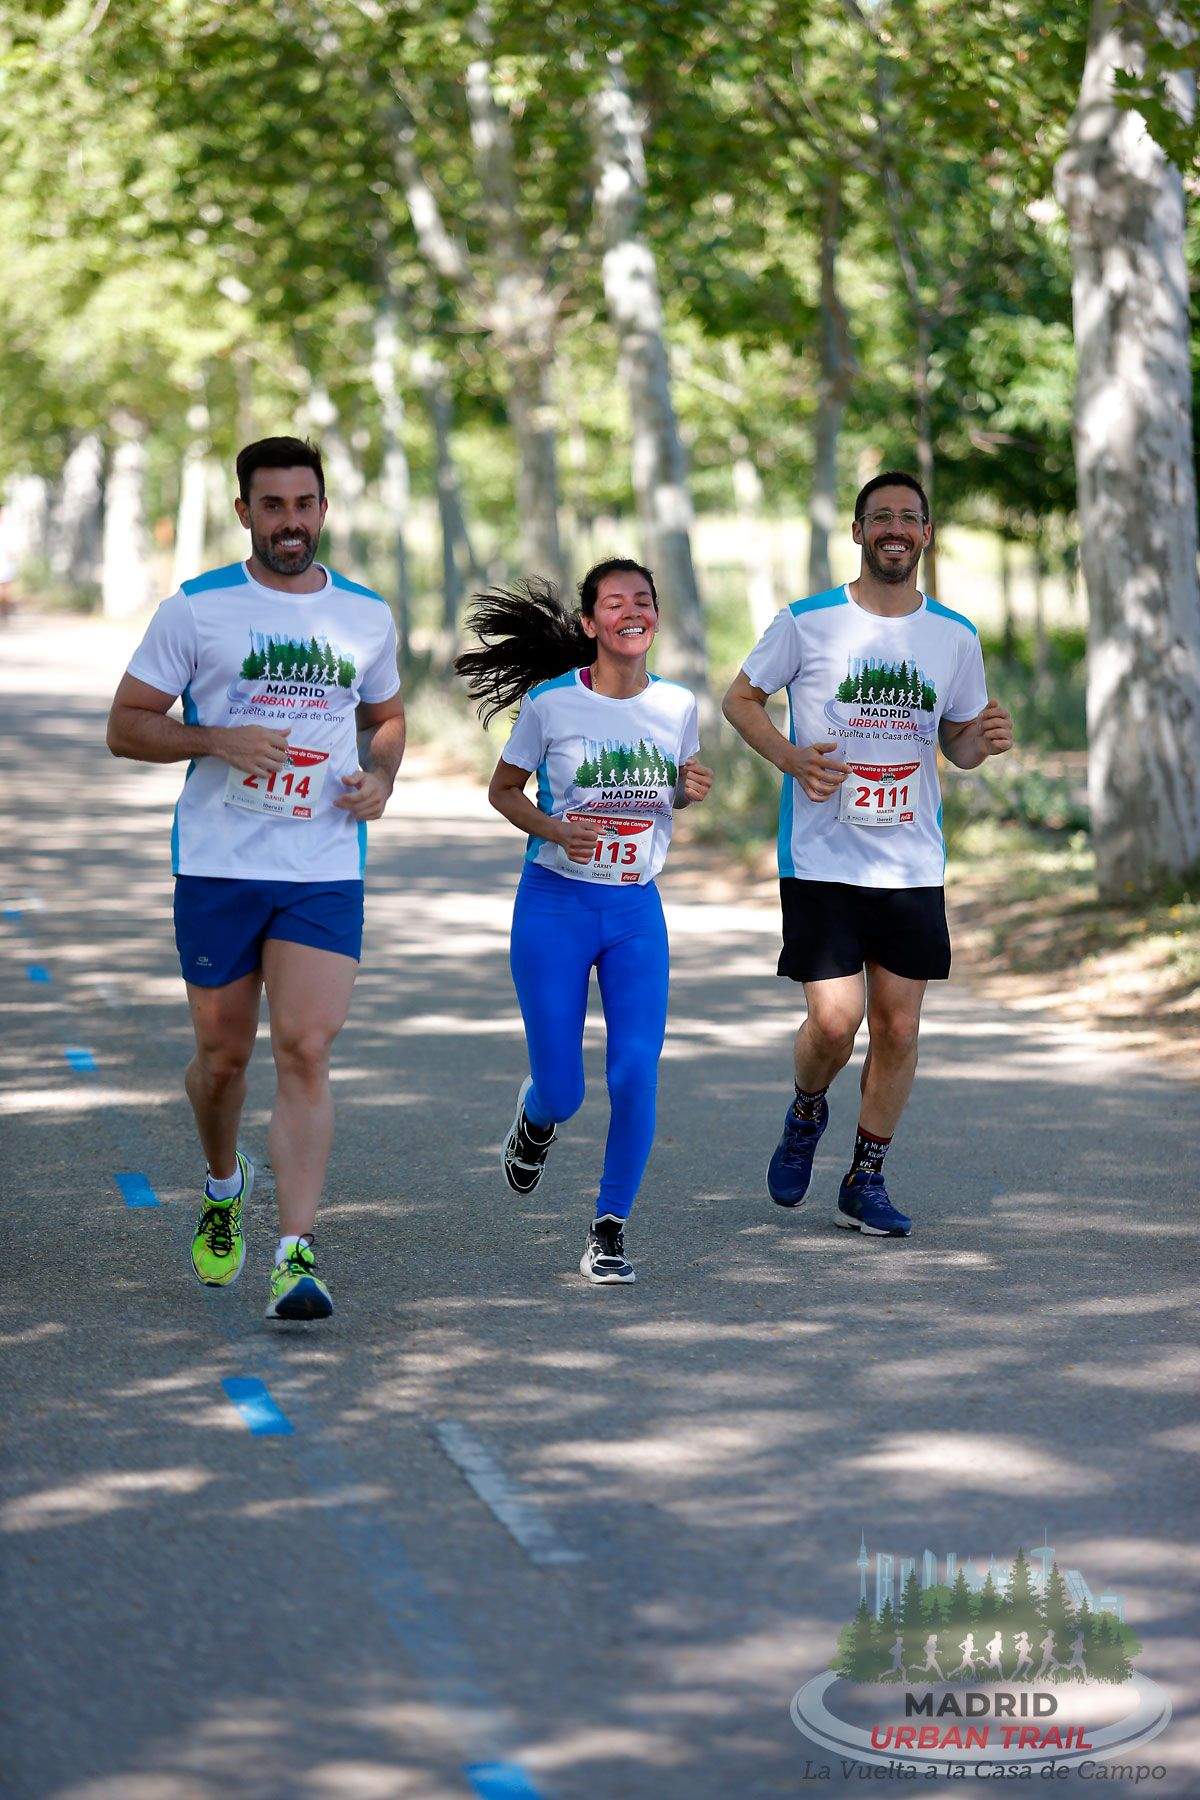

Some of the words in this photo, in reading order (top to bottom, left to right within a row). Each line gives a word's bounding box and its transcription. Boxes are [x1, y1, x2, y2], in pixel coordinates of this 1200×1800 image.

[266, 683, 325, 698] MADRID
[251, 695, 295, 708] URBAN
[276, 709, 286, 719] la
[310, 711, 321, 721] de
[860, 707, 911, 719] MADRID
[848, 718, 887, 729] URBAN
[891, 720, 919, 732] TRAIL
[827, 728, 837, 737] La
[839, 729, 864, 739] Vuelta
[872, 731, 880, 739] la
[882, 732, 902, 741] Casa
[903, 732, 912, 741] de
[243, 771, 311, 798] 2114
[602, 790, 658, 799] MADRID
[855, 786, 908, 807] 2111
[634, 801, 664, 809] TRAIL
[594, 840, 638, 865] 113
